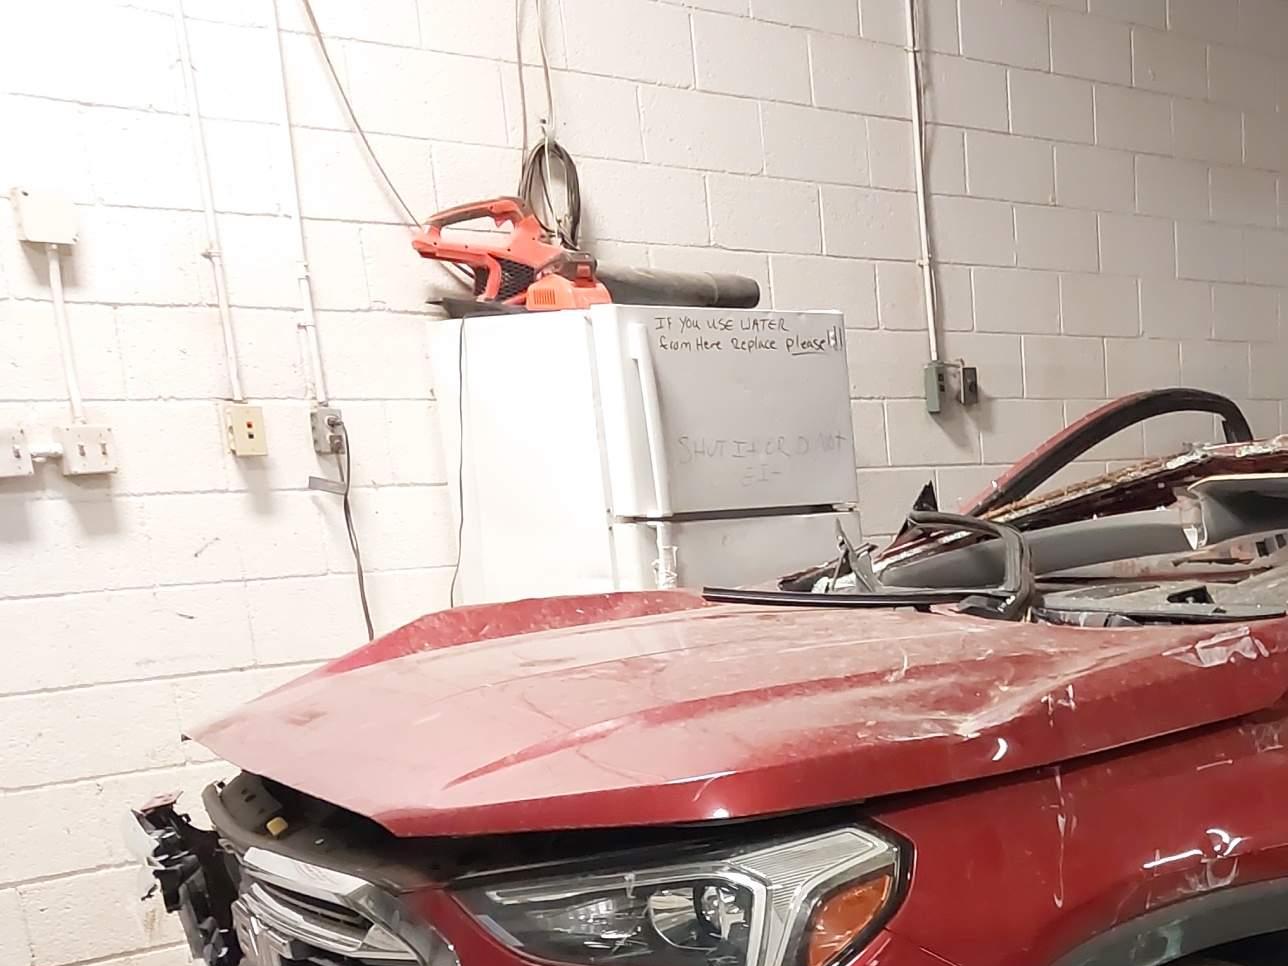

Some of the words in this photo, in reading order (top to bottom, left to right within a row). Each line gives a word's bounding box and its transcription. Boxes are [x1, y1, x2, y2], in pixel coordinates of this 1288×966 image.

[655, 316, 673, 330] IF
[740, 318, 789, 332] WATER
[660, 336, 692, 351] from
[696, 337, 722, 350] Here
[731, 338, 777, 352] Replace
